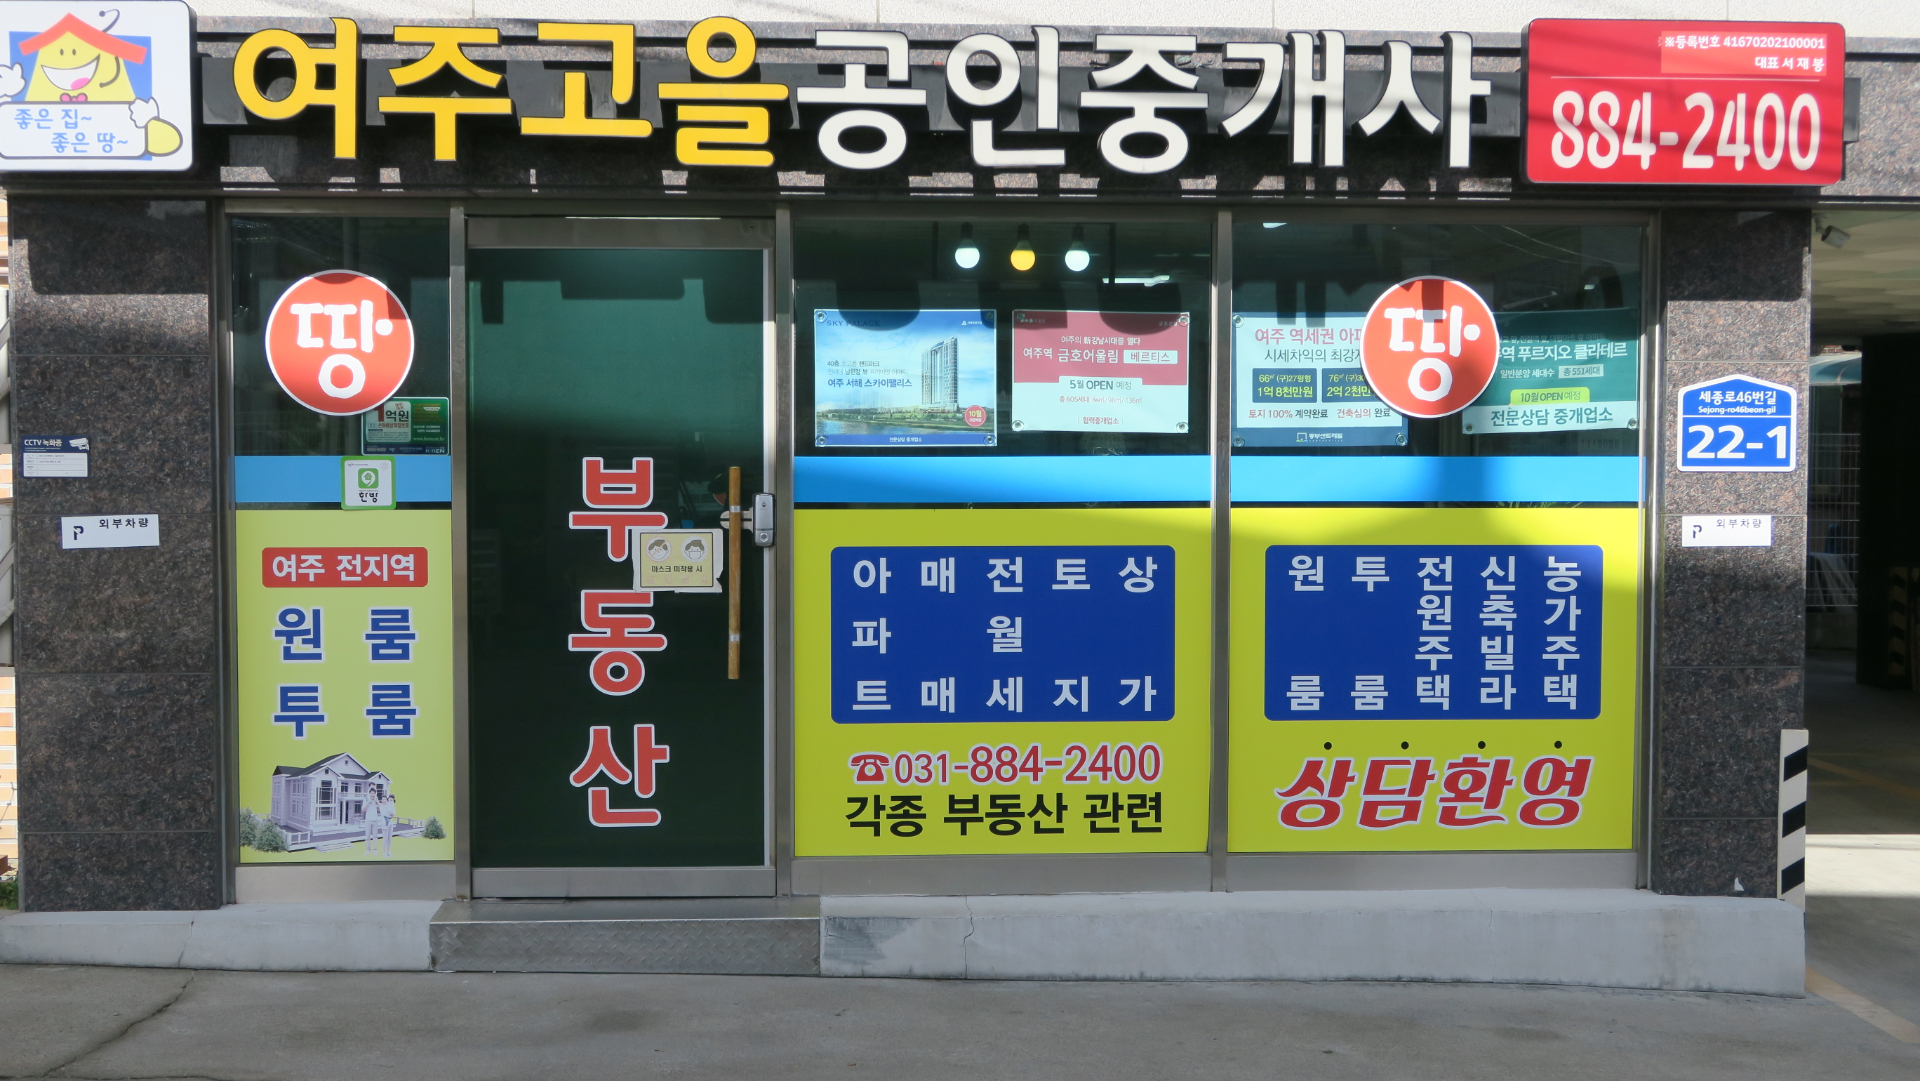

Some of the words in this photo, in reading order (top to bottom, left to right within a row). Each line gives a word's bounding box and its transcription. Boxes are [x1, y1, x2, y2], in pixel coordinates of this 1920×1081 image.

[1723, 36, 1826, 49] 41670202100001
[1755, 56, 1779, 69] 대표
[14, 109, 53, 129] 좋은
[1551, 90, 1820, 171] 884-2400
[51, 132, 90, 153] 좋은
[1061, 336, 1082, 344] 여주의
[1255, 329, 1285, 345] 여주
[1290, 328, 1335, 345] 역세권
[290, 300, 394, 399] 땅
[1023, 348, 1053, 359] 여주역
[1058, 349, 1119, 364] 금호어울림
[1130, 351, 1171, 363] 베르티스
[1265, 349, 1326, 363] 시세차익의
[1384, 305, 1480, 402] 땅
[1518, 345, 1572, 362] 푸르지오
[1574, 342, 1628, 360] 클라테르
[1501, 369, 1531, 379] 일반분양
[828, 379, 844, 388] 여주
[846, 379, 862, 388] 서해
[1070, 380, 1084, 389] 5월
[1086, 380, 1113, 390] OPEN
[1116, 381, 1132, 390] 예정
[1326, 386, 1343, 397] 2억
[1258, 386, 1274, 397] 1억
[1276, 386, 1313, 398] 8천만원
[1698, 390, 1777, 405] 세종로46번길
[1249, 409, 1265, 418] 토지
[1268, 409, 1293, 418] 100%
[1294, 409, 1328, 418] 계약완료
[1337, 409, 1371, 418] 건축심의
[1491, 408, 1550, 427] 전문상담
[1554, 406, 1614, 425] 중개업소
[1698, 406, 1777, 415] Sejong-ro46beon-gil
[1687, 425, 1787, 459] 22-1
[272, 554, 325, 582] 여주
[336, 554, 415, 582] 전지역
[652, 565, 671, 573] 마스크
[893, 741, 1163, 785] 031-884-2400
[1274, 754, 1595, 829] 상담환영
[846, 794, 927, 837] 각종
[944, 792, 1068, 836] 부동산
[1083, 792, 1162, 834] 관련
